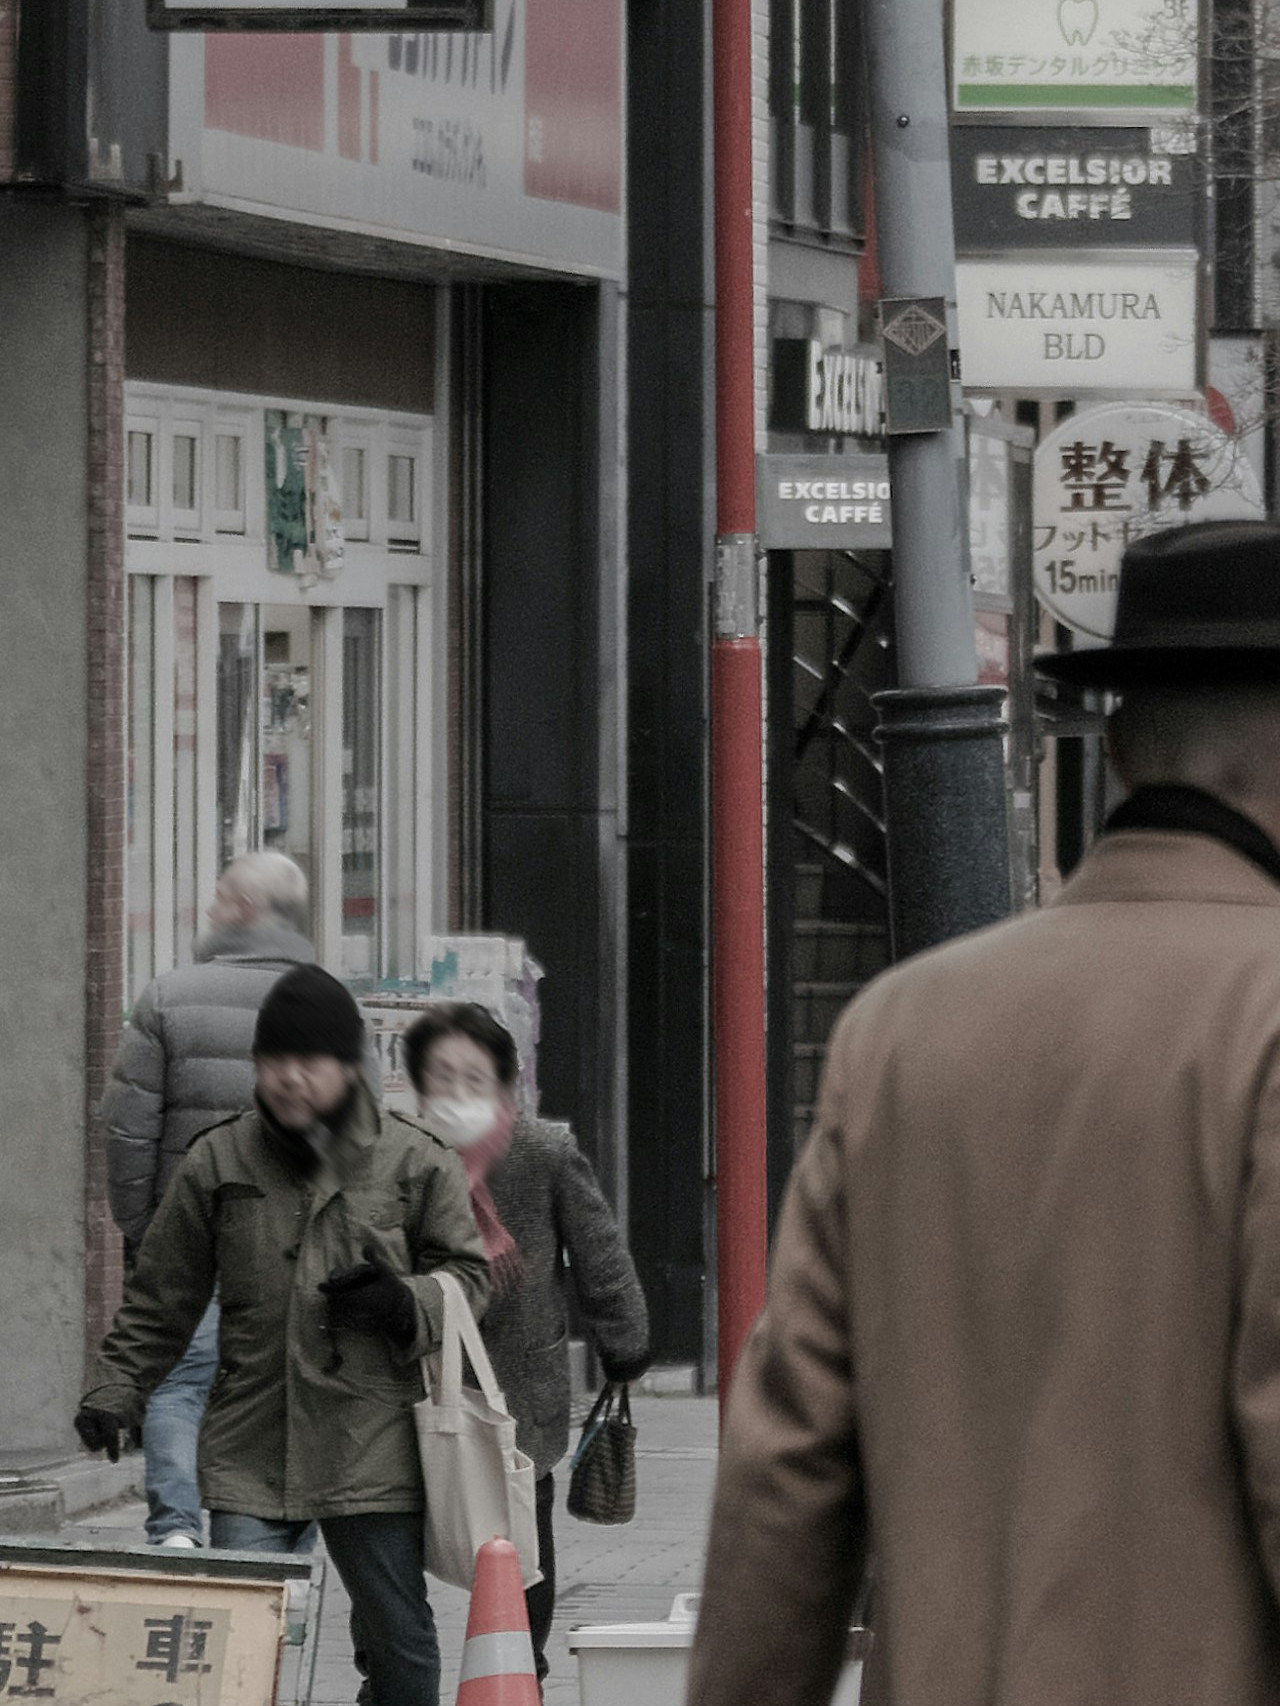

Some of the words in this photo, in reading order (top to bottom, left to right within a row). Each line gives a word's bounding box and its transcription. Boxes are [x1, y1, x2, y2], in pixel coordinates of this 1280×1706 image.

[976, 158, 1172, 187] EXCELSIOR
[986, 293, 1162, 320] NAKAMURA
[1043, 333, 1106, 361] BLD
[1060, 441, 1211, 511] 整体
[805, 502, 883, 524] CAFFÉ
